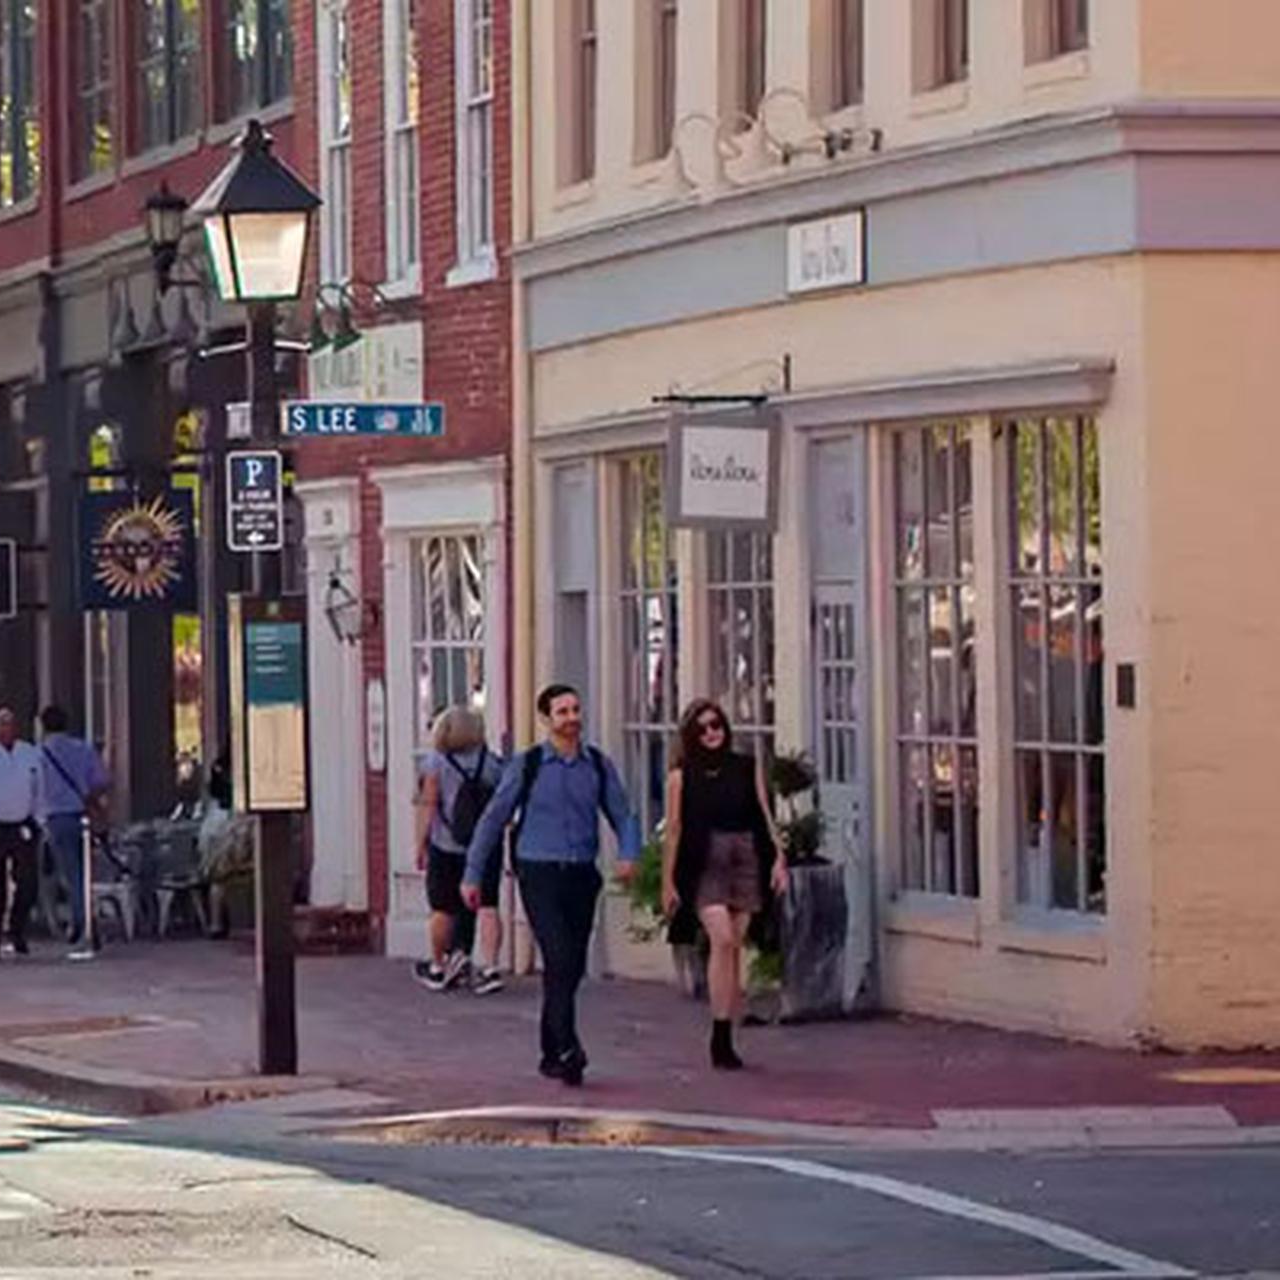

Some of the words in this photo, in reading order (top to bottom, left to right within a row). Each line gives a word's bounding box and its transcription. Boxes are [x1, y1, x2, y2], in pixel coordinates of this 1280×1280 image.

[292, 406, 307, 431] S
[316, 407, 357, 432] LEE
[245, 459, 263, 487] P
